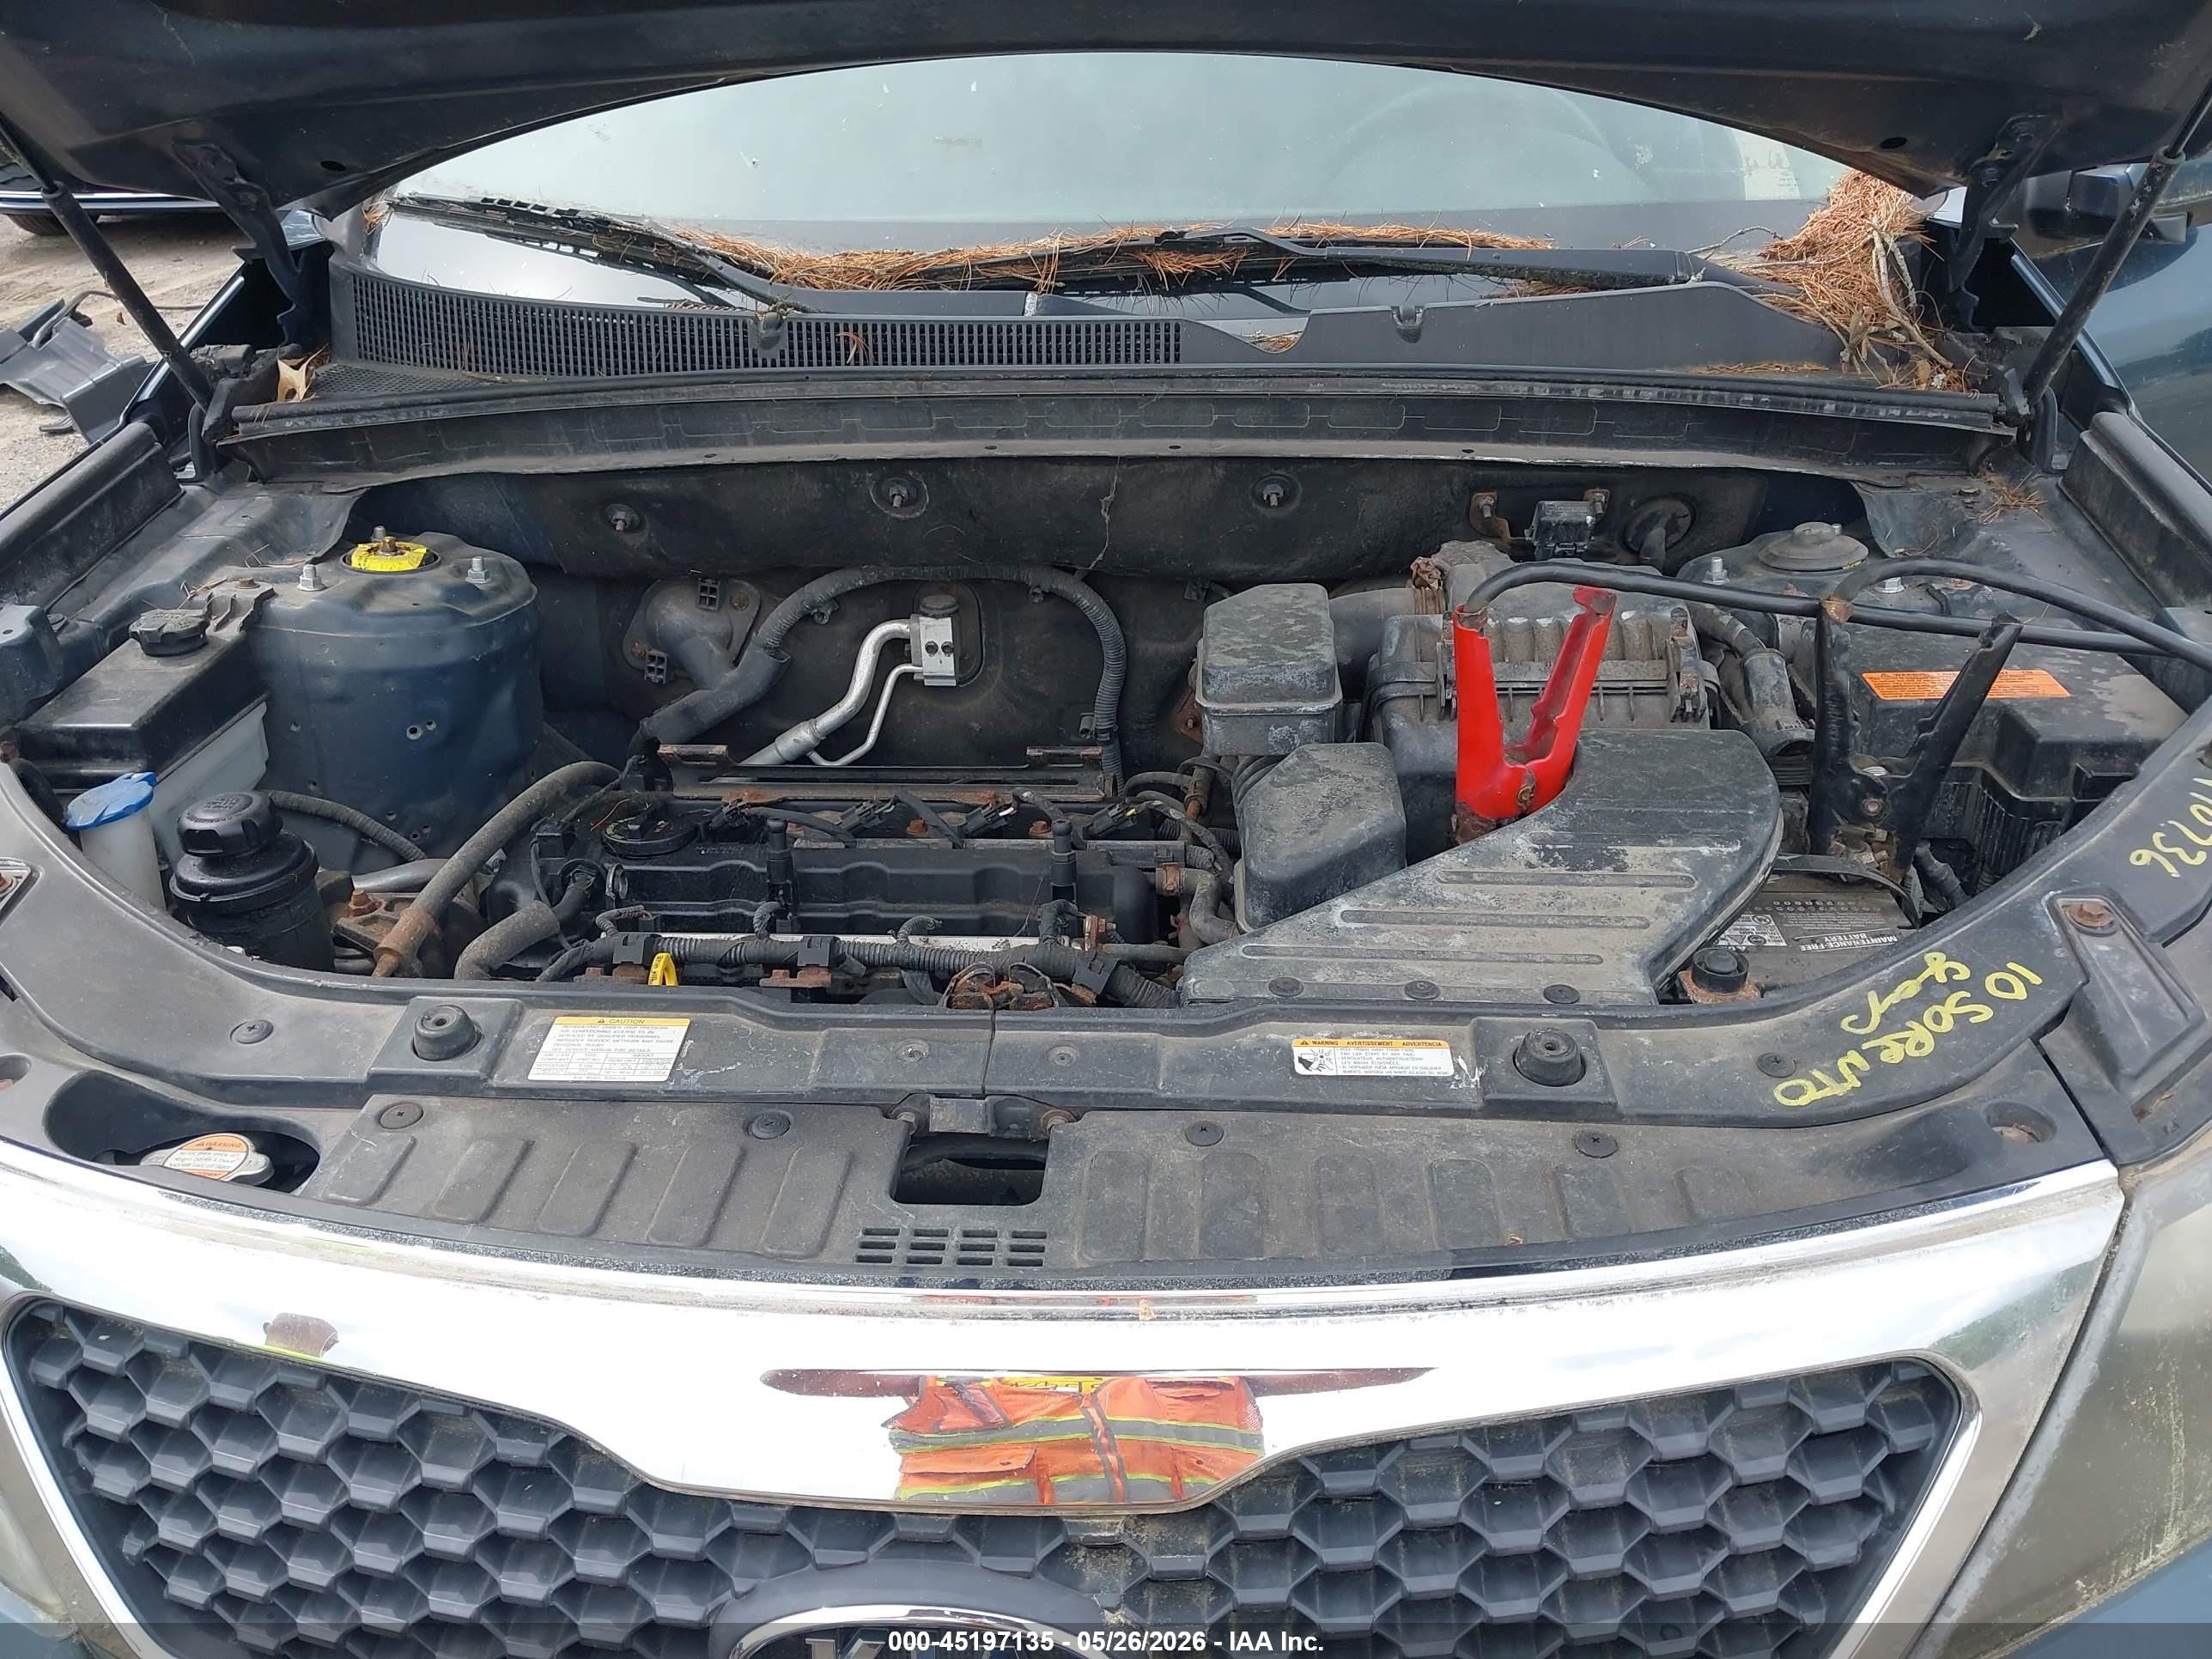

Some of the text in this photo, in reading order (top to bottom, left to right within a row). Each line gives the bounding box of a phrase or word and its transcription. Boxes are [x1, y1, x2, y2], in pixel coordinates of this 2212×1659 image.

[1799, 934, 1898, 951] MAINTENANCE-FREE
[1824, 933, 1868, 943] BATTERY
[1984, 962, 2043, 1000] 10
